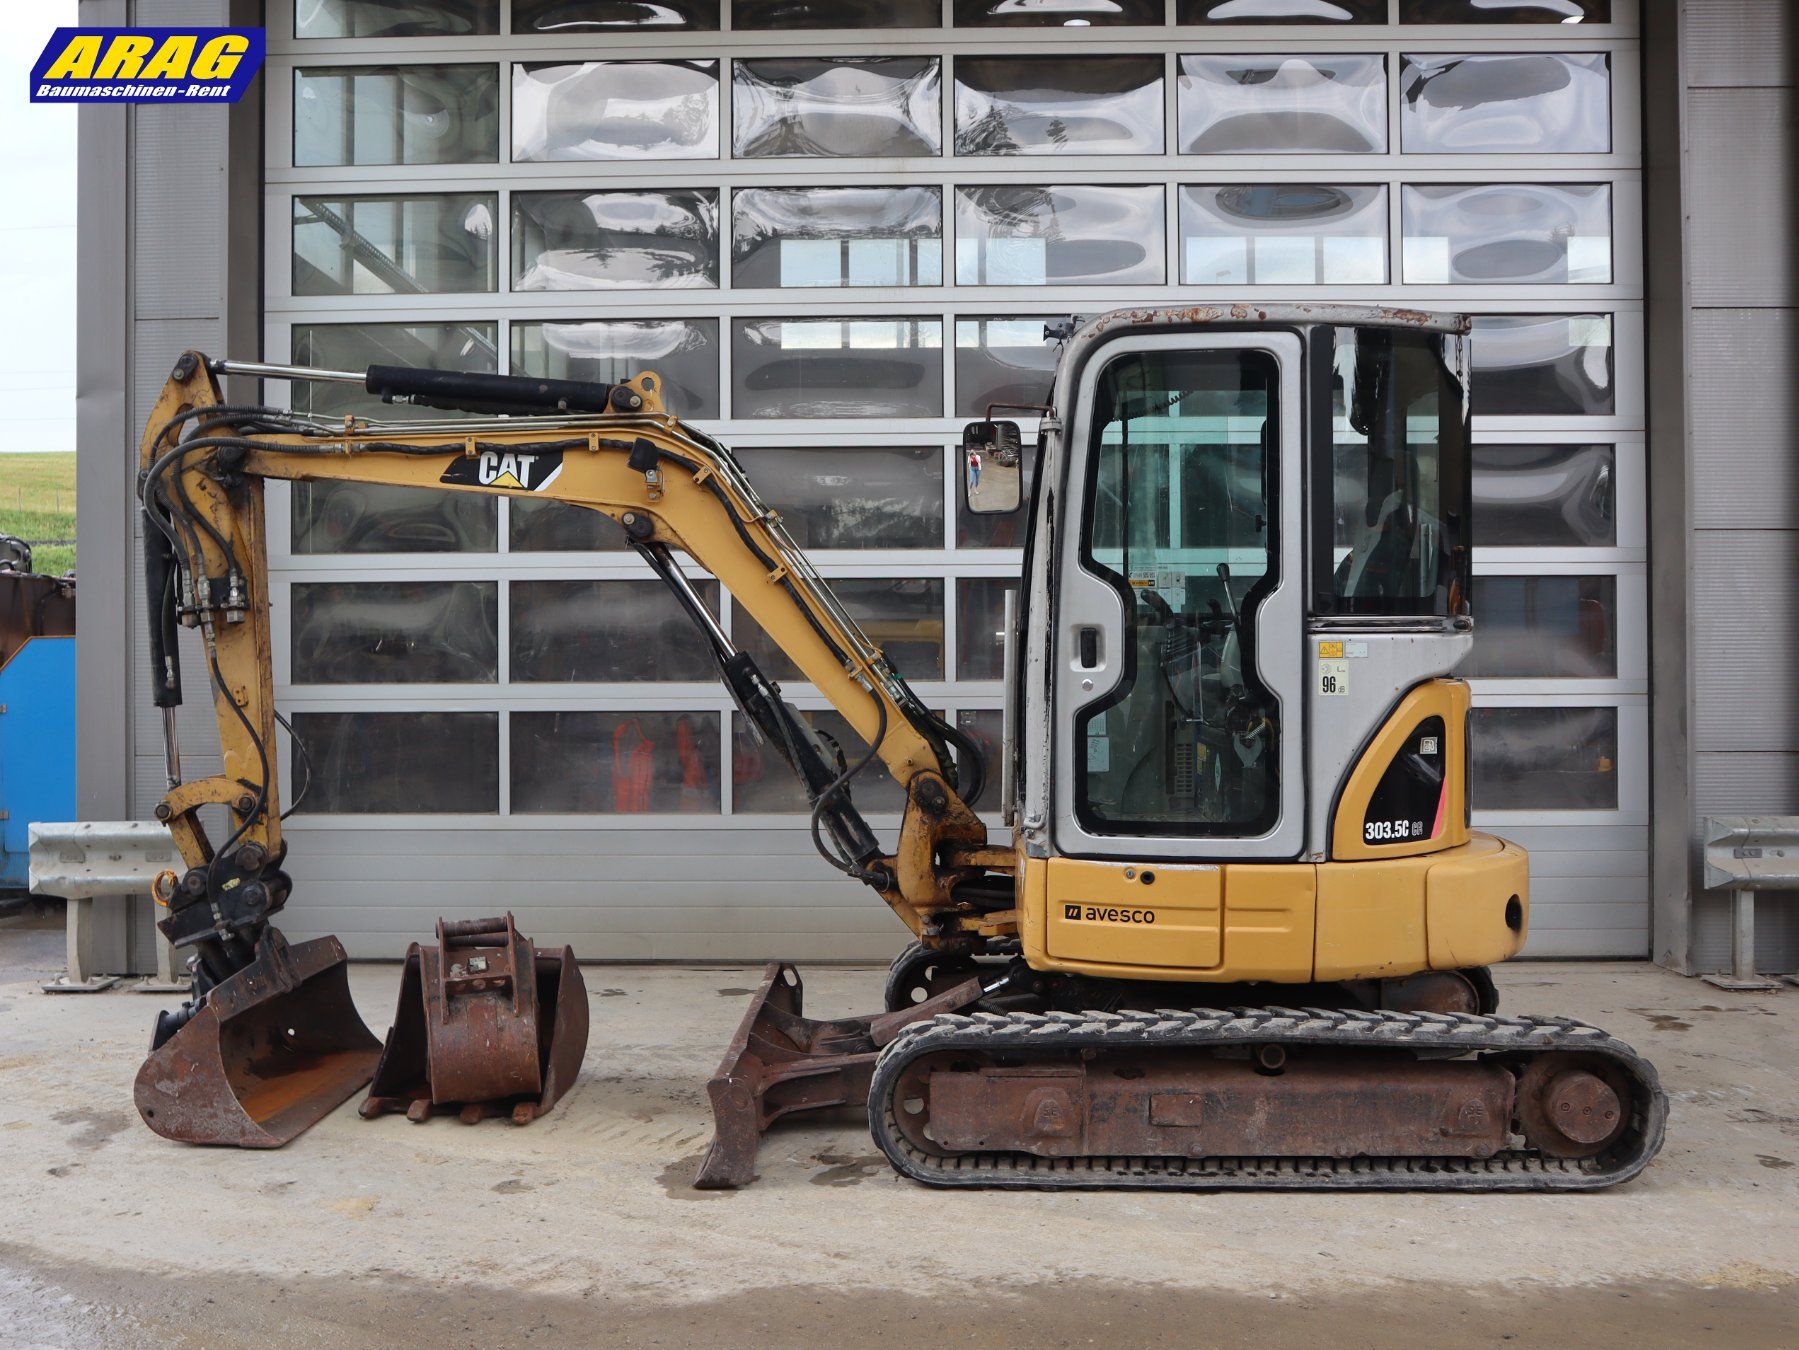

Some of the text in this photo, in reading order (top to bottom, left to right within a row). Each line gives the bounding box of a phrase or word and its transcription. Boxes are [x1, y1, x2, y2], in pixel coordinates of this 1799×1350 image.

[478, 451, 535, 488] CAT
[1322, 676, 1336, 693] 96
[1365, 820, 1409, 839] 303.5C
[1085, 907, 1155, 924] avesco
